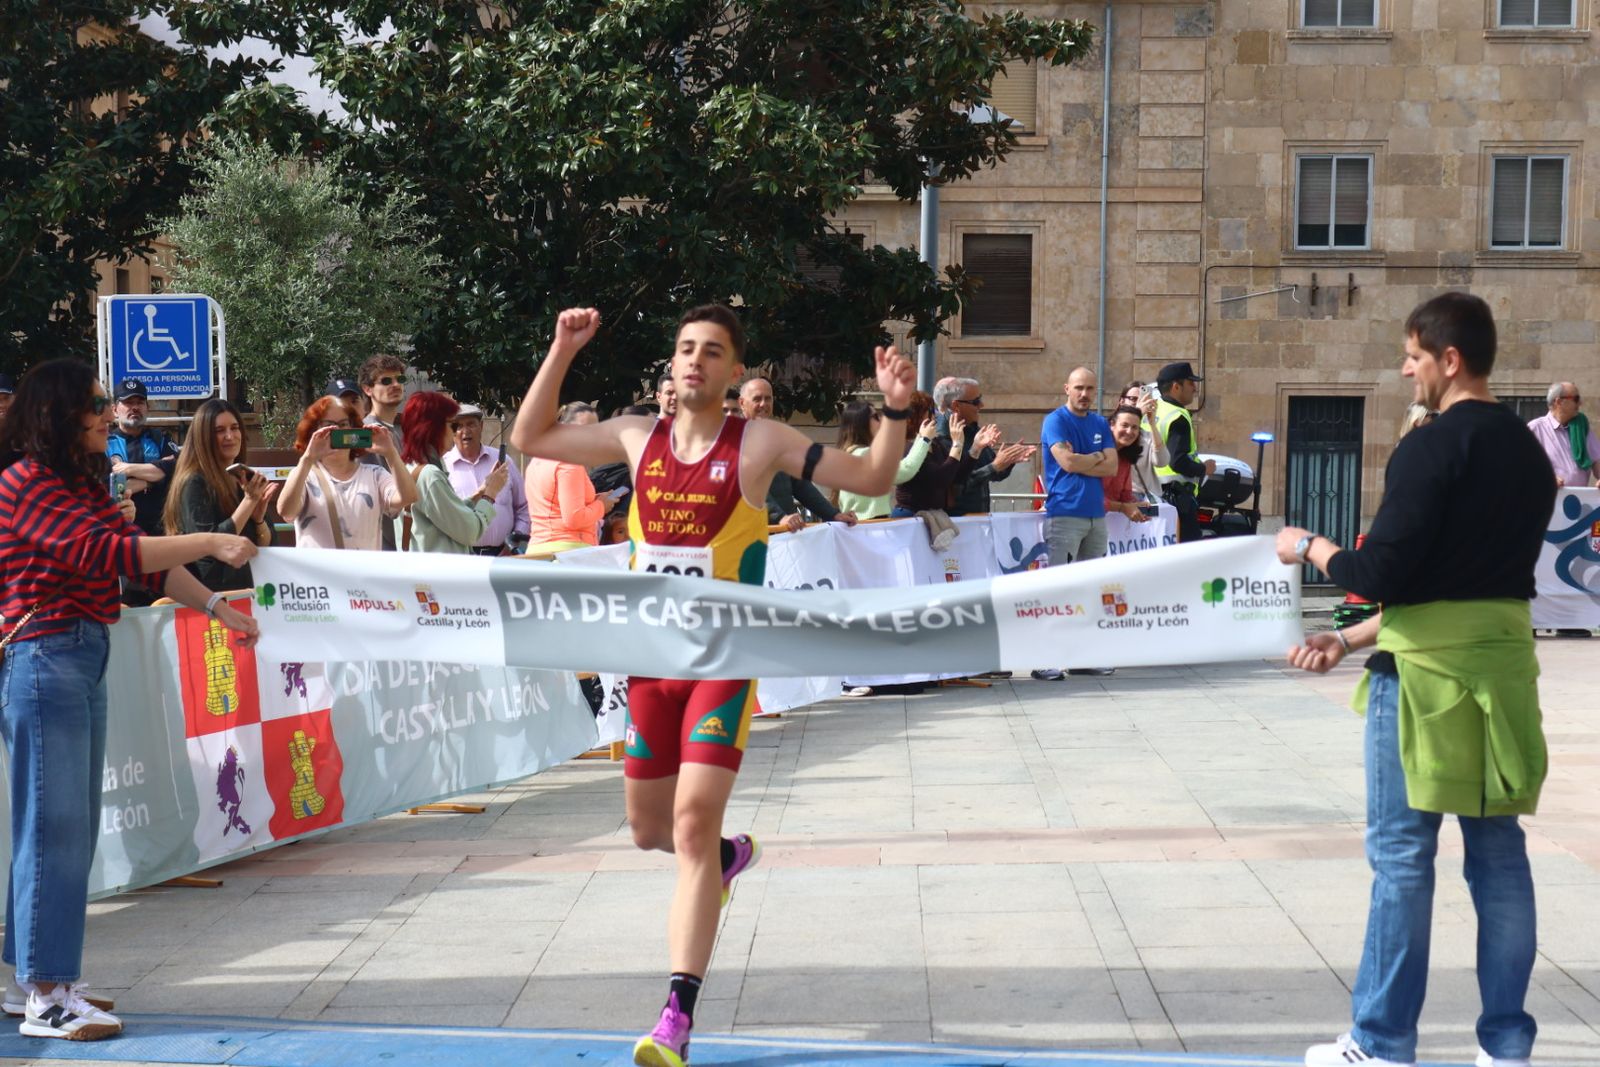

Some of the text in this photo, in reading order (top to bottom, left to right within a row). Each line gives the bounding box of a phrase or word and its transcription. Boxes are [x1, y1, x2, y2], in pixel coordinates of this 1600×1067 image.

[172, 385, 210, 393] REDUCIDA
[687, 493, 717, 504] RURAL
[660, 509, 695, 521] VINO
[648, 521, 706, 535] DE TORO
[279, 582, 329, 600] Plena
[1231, 576, 1291, 595] Plena
[346, 589, 368, 598] NOS
[282, 600, 330, 611] inclusión
[1014, 599, 1042, 609] NOS
[1232, 596, 1291, 608] inclusión
[443, 606, 489, 616] Junta de
[505, 586, 572, 622] DÍA
[579, 593, 628, 624] DE
[638, 597, 822, 631] CASTILLA
[866, 600, 985, 633] LEÓN
[1132, 603, 1188, 615] Junta de
[284, 614, 312, 622] Castilla
[416, 616, 490, 629] Castilla y León
[1097, 616, 1189, 630] Castilla y León
[388, 660, 420, 689] DE
[501, 675, 550, 719] LEÓN
[122, 756, 145, 787] de
[102, 798, 150, 835] León
